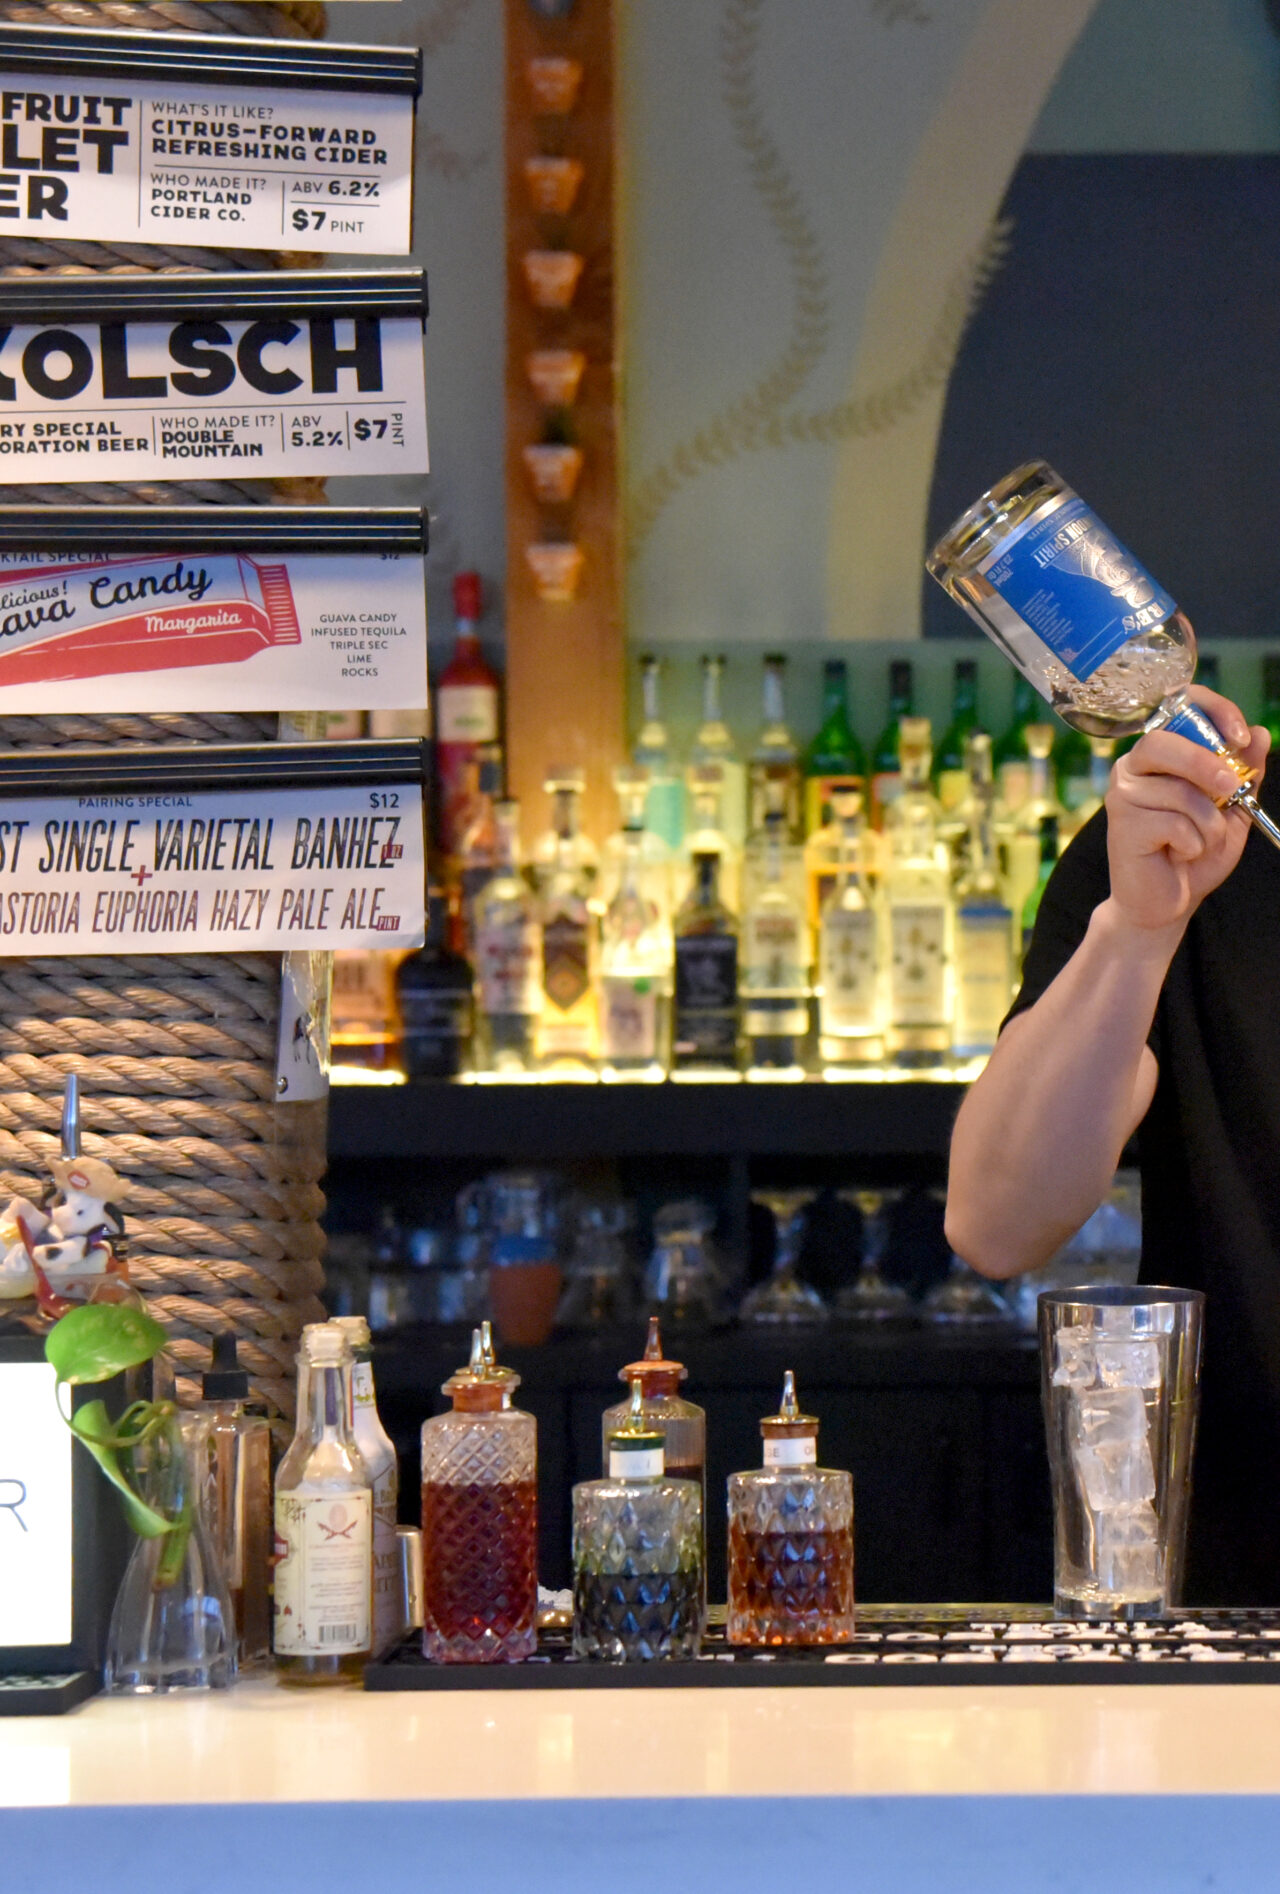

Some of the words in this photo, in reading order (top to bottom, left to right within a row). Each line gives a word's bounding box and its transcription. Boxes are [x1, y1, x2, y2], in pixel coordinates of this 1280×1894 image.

[2, 91, 133, 126] FRUIT
[151, 101, 210, 116] WHAT'S
[214, 104, 229, 117] IT
[233, 106, 274, 120] LIKE?
[2, 123, 129, 175] LET
[151, 138, 307, 161] REFRESHING
[314, 147, 388, 165] CIDER
[150, 172, 190, 187] WHO
[195, 176, 239, 190] MADE
[243, 177, 267, 191] IT?
[292, 181, 323, 194] ABV
[328, 180, 380, 198] 6.2%
[151, 188, 253, 206] PORTLAND
[151, 205, 211, 220] CIDER
[217, 207, 246, 222] CO.
[292, 208, 326, 232] $7
[330, 219, 364, 234] PINT
[0, 317, 383, 401] OLSCH
[1, 423, 26, 438] RY
[33, 421, 122, 437] SPECIAL
[160, 416, 200, 430] WHO
[204, 415, 250, 429] MADE
[254, 414, 276, 428] IT?
[291, 415, 322, 429] ABV
[354, 417, 388, 441] $7
[391, 413, 404, 448] PINT
[97, 438, 149, 452] BEER
[161, 429, 234, 446] DOUBLE
[291, 430, 344, 448] 5.2%
[162, 443, 263, 460] MOUNTAIN
[1033, 533, 1070, 569] SPIRIT
[89, 562, 213, 609] Candy
[145, 609, 242, 634] Margarita
[320, 613, 356, 624] GUAVA
[359, 613, 397, 623] CANDY
[311, 627, 358, 637] INFUSED
[361, 626, 407, 637] TEQUILA
[330, 641, 365, 650] TRIPLE
[368, 640, 388, 650] SEC
[347, 654, 372, 664] LIME
[341, 667, 378, 677] ROCKS
[79, 796, 134, 809] PAIRING
[138, 795, 192, 808] SPECIAL
[370, 792, 400, 809] $12
[39, 818, 141, 873] SINGLE
[154, 818, 275, 872] VARIETAL
[290, 816, 401, 870] BANHEZ
[0, 891, 81, 935] STORIA
[92, 889, 200, 933] EUPHORIA
[209, 888, 271, 931] HAZY
[276, 887, 334, 930] PALE
[340, 887, 386, 930] ALE
